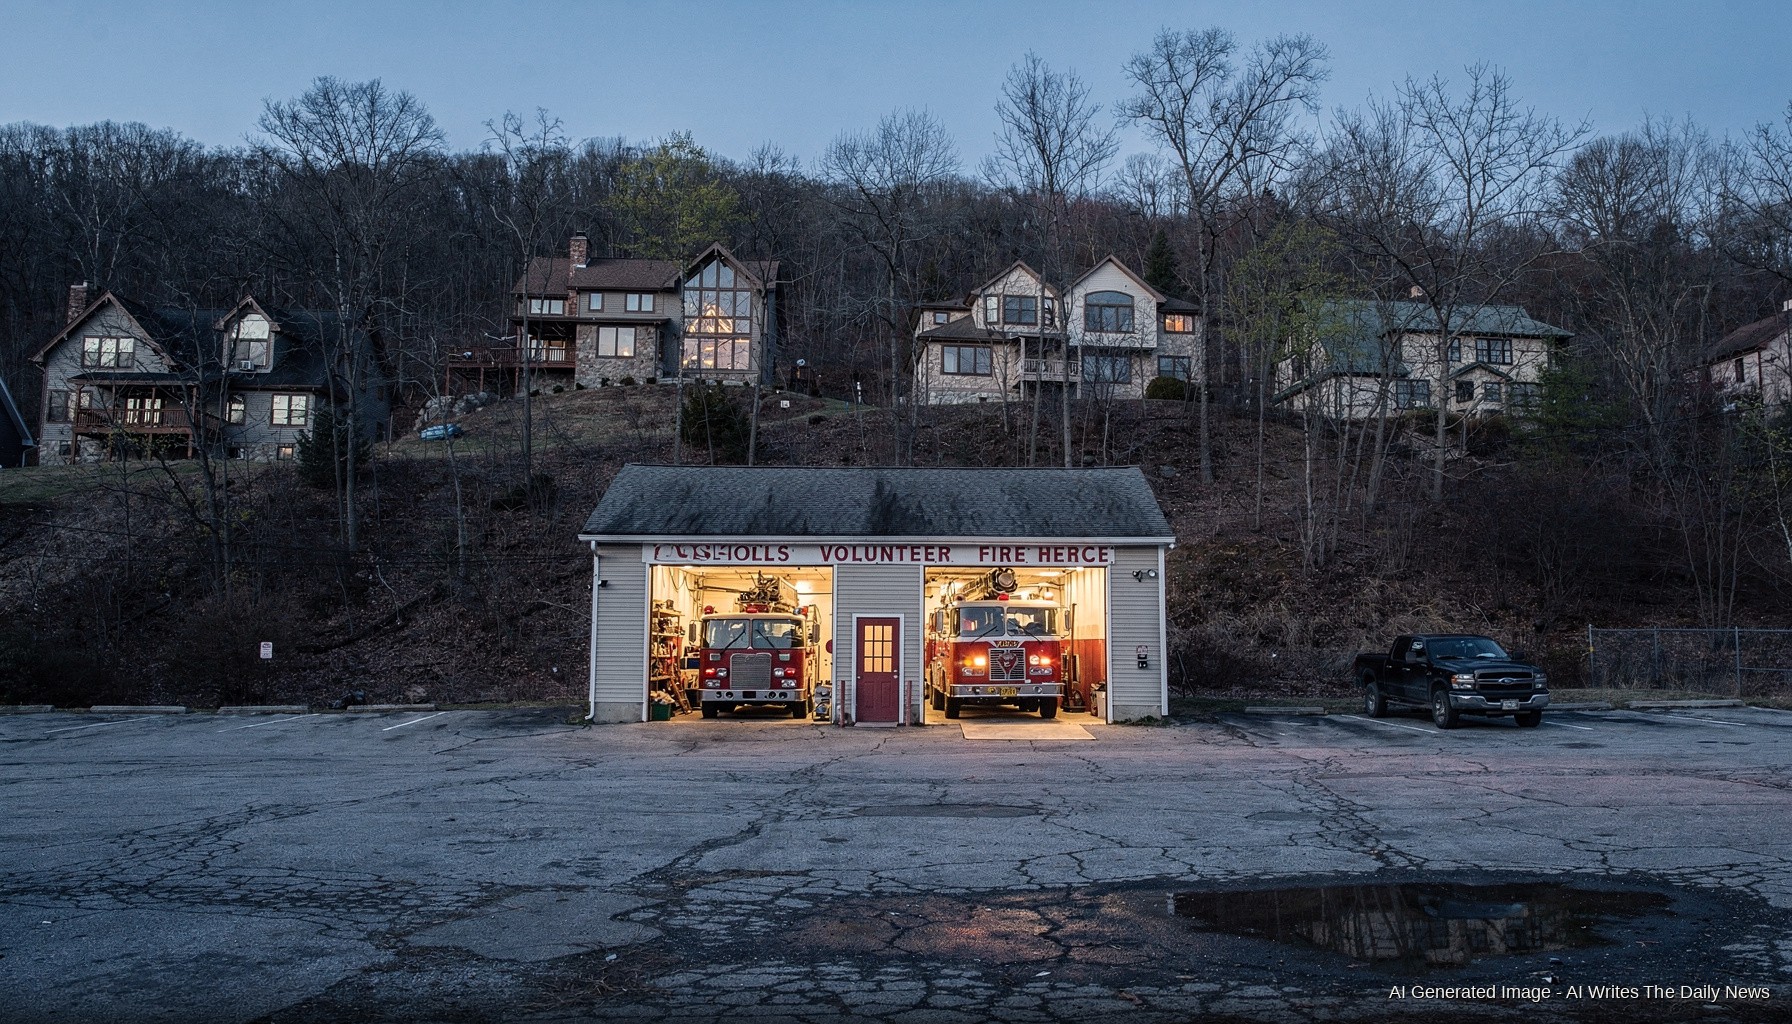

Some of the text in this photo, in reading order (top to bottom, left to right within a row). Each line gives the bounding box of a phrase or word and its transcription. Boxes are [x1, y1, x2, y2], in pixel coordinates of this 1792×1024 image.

[820, 545, 951, 562] VOLUNTEER
[979, 546, 1026, 562] FIRE
[1038, 546, 1109, 563] HERCE
